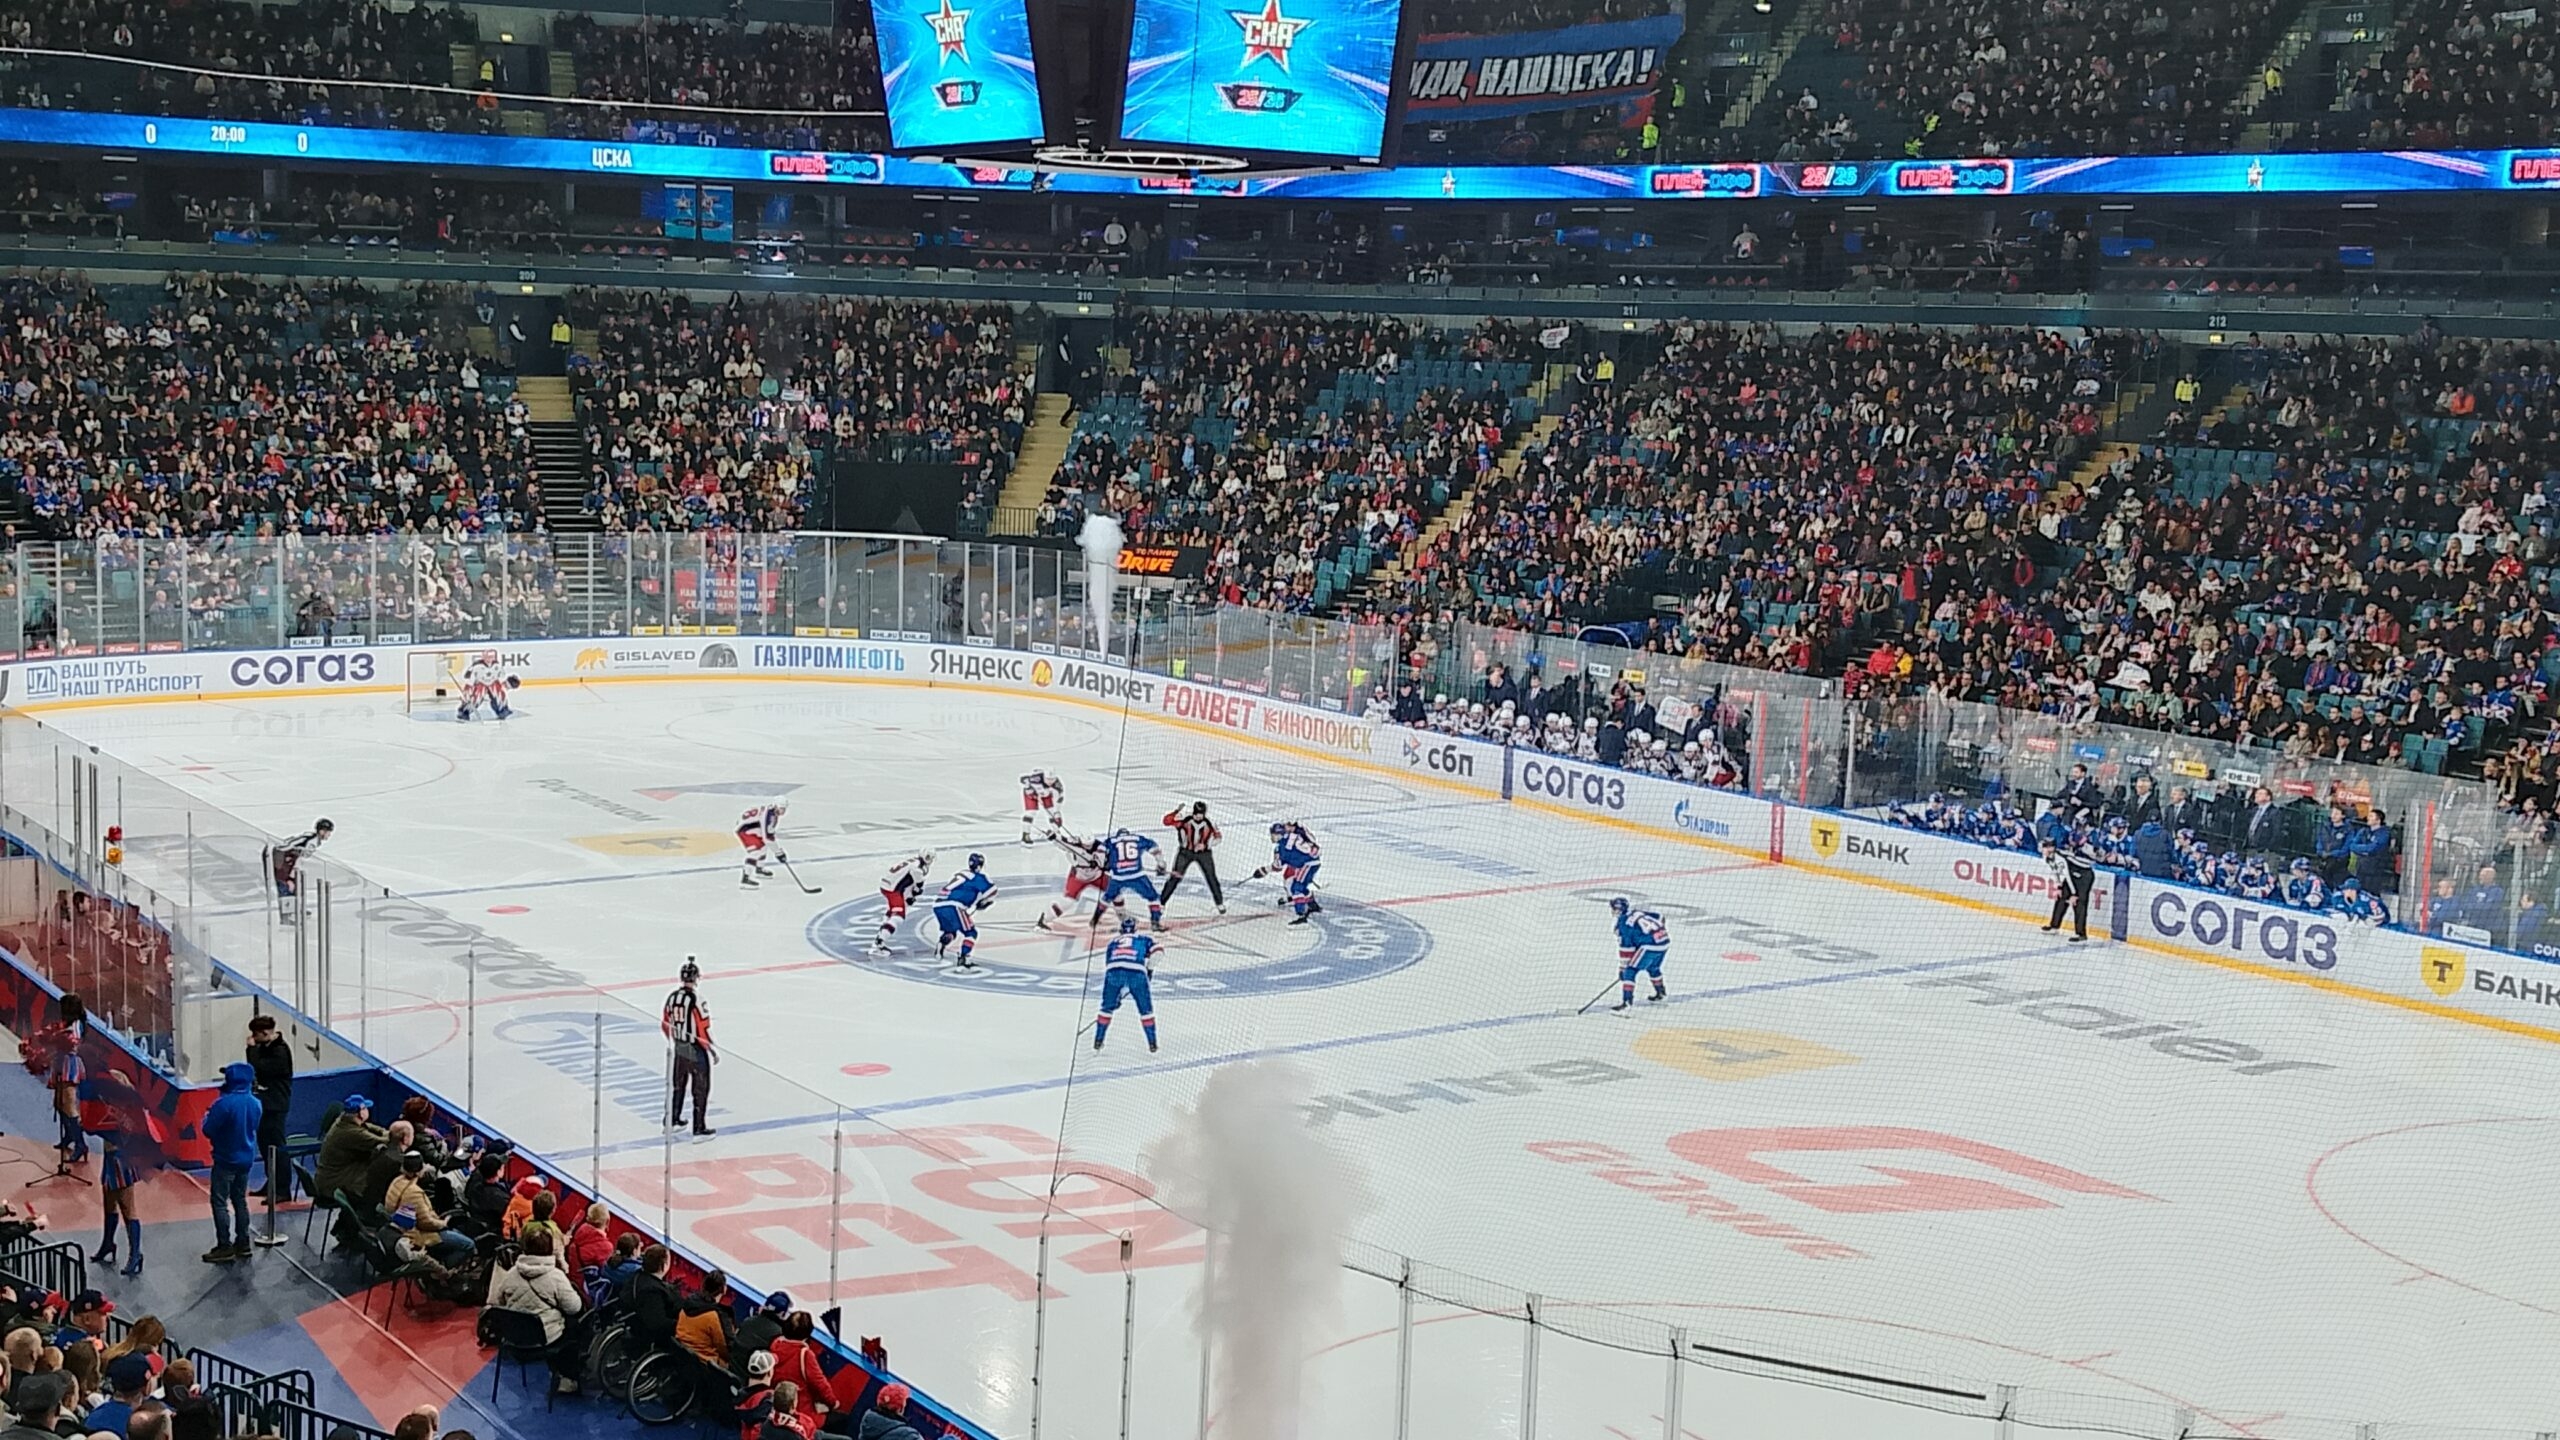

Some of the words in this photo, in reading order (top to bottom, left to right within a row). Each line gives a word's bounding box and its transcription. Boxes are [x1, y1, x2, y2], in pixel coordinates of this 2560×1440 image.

[2346, 13, 2364, 23] 412
[935, 16, 965, 43] СКА
[1244, 20, 1294, 47] СКА
[145, 124, 157, 145] 0
[210, 126, 246, 144] 20:00
[297, 132, 308, 153] 0
[592, 148, 633, 168] ЦСКА
[773, 155, 877, 176] ПЛЕЙ-ОФФ
[1654, 169, 1754, 191] ПЛЕЙ-ОФФ
[1801, 166, 1859, 188] 25/26
[1901, 165, 2005, 189] ПЛЕЙ-ОФФ
[519, 271, 536, 281] 209
[1076, 291, 1093, 301] 210
[1622, 305, 1639, 316] 211
[2208, 316, 2228, 328] 212
[613, 650, 696, 662] GISLAVED
[754, 644, 905, 672] ГАЗПРОМНЕФТЬ
[61, 662, 99, 680] ВАШ
[103, 660, 147, 677] ПУТЬ
[929, 648, 1024, 681] Яндекс
[1059, 662, 1155, 704] Маркет
[61, 679, 100, 698] НАШ
[105, 675, 204, 695] ТРАНСПОРТ
[1162, 683, 1257, 731] FONBET
[1263, 706, 1374, 756] КИНОПОИСК
[1427, 745, 1474, 777] сбп
[1115, 841, 1139, 861] 16
[1846, 834, 1911, 866] БАНК
[1953, 859, 2108, 910] OLIMPT
[2474, 968, 2560, 1007] БАНК
[1903, 971, 2338, 1076] Haier
[598, 1152, 1071, 1303] BET
